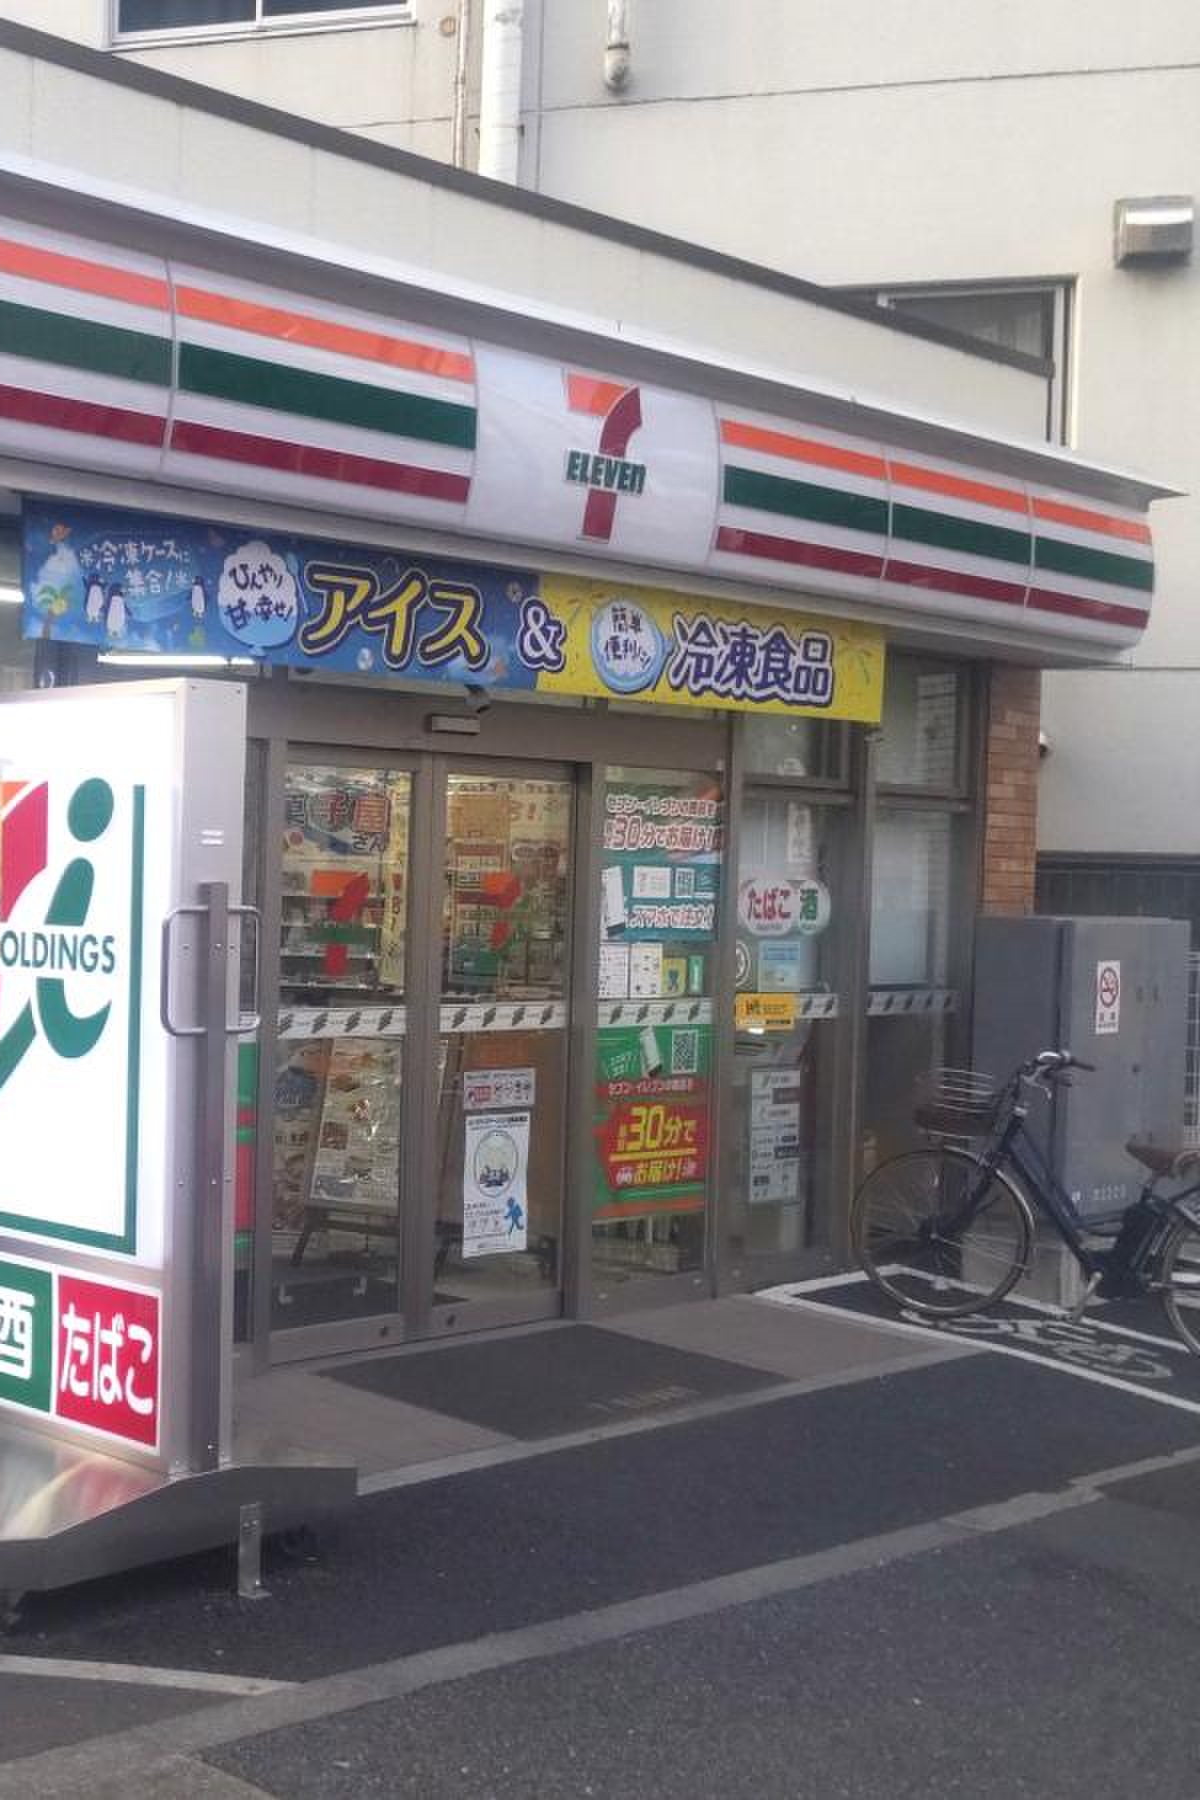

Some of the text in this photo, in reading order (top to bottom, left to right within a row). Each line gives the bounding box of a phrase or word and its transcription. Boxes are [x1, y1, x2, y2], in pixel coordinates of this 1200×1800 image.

[229, 563, 283, 590] ひんやり
[300, 559, 567, 672] アイス &
[667, 611, 834, 708] 冷凍食品
[747, 887, 791, 923] たばこ
[60, 1303, 154, 1414] たばこ
